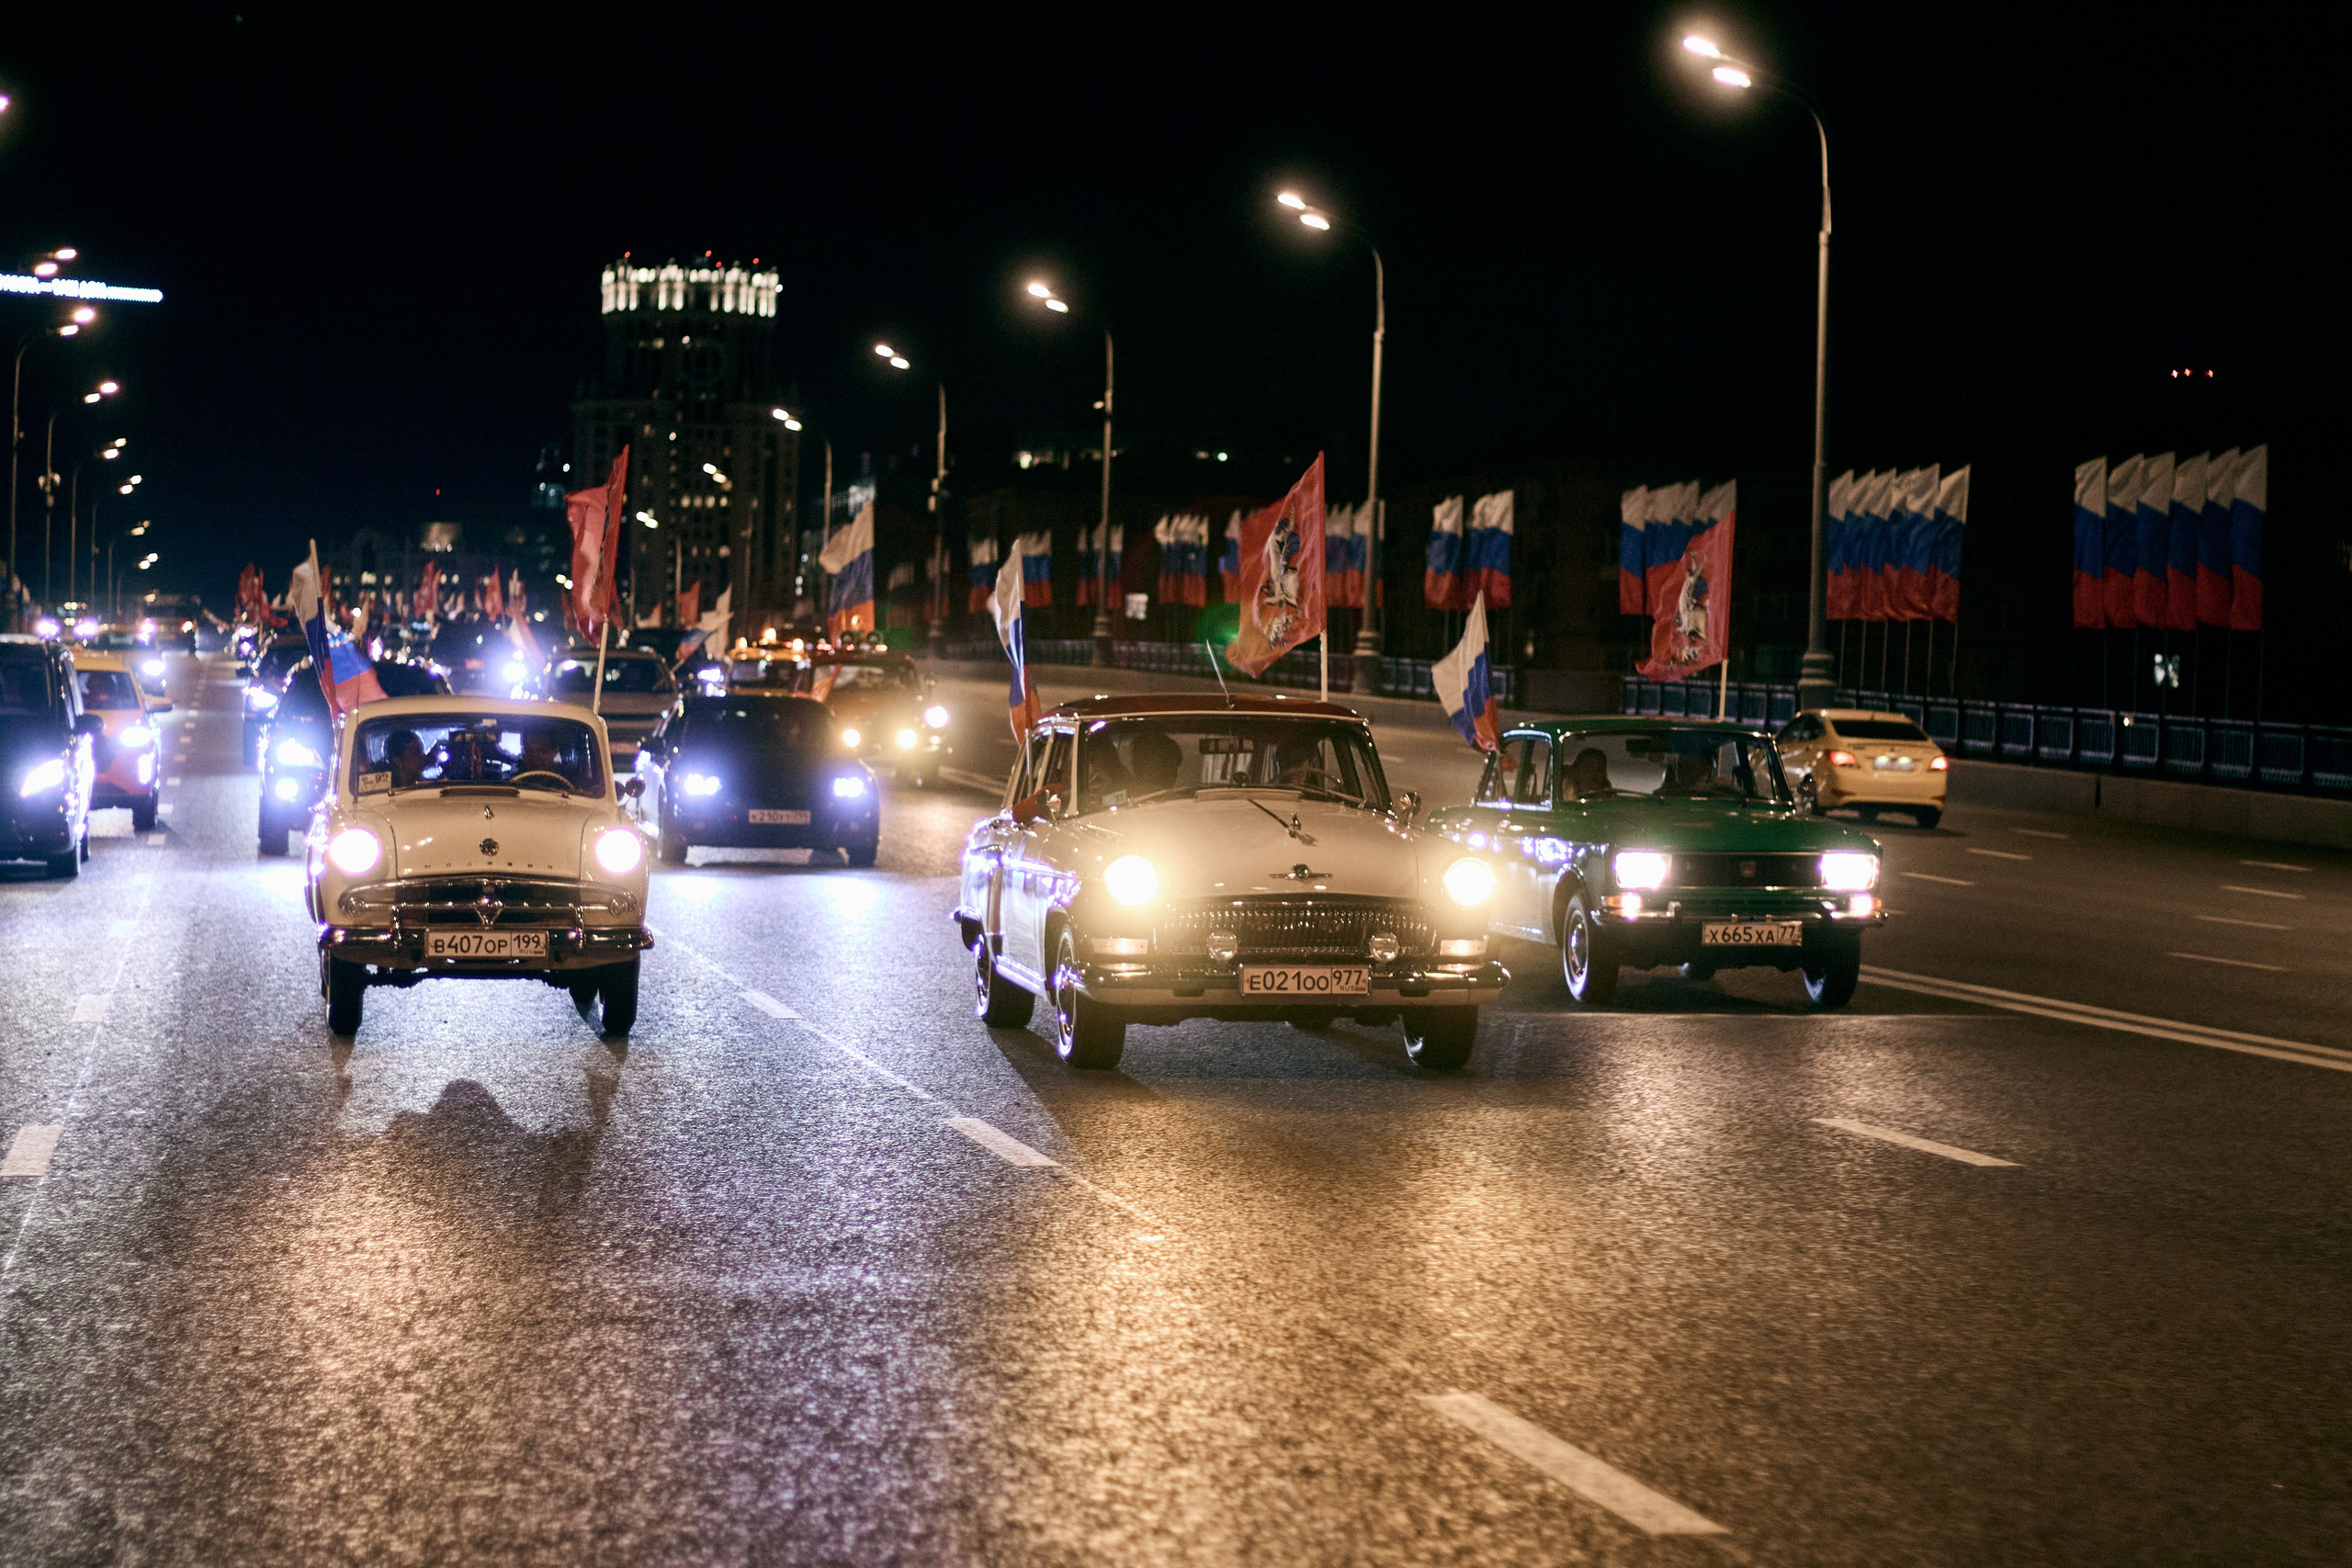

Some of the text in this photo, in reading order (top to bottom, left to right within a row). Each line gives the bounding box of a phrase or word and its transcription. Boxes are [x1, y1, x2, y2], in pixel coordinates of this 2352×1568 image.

[434, 934, 541, 954] В407ОР 199
[1710, 926, 1775, 943] Х665ХА
[1780, 925, 1796, 938] 77
[1250, 970, 1363, 991] Е021ОО 977
